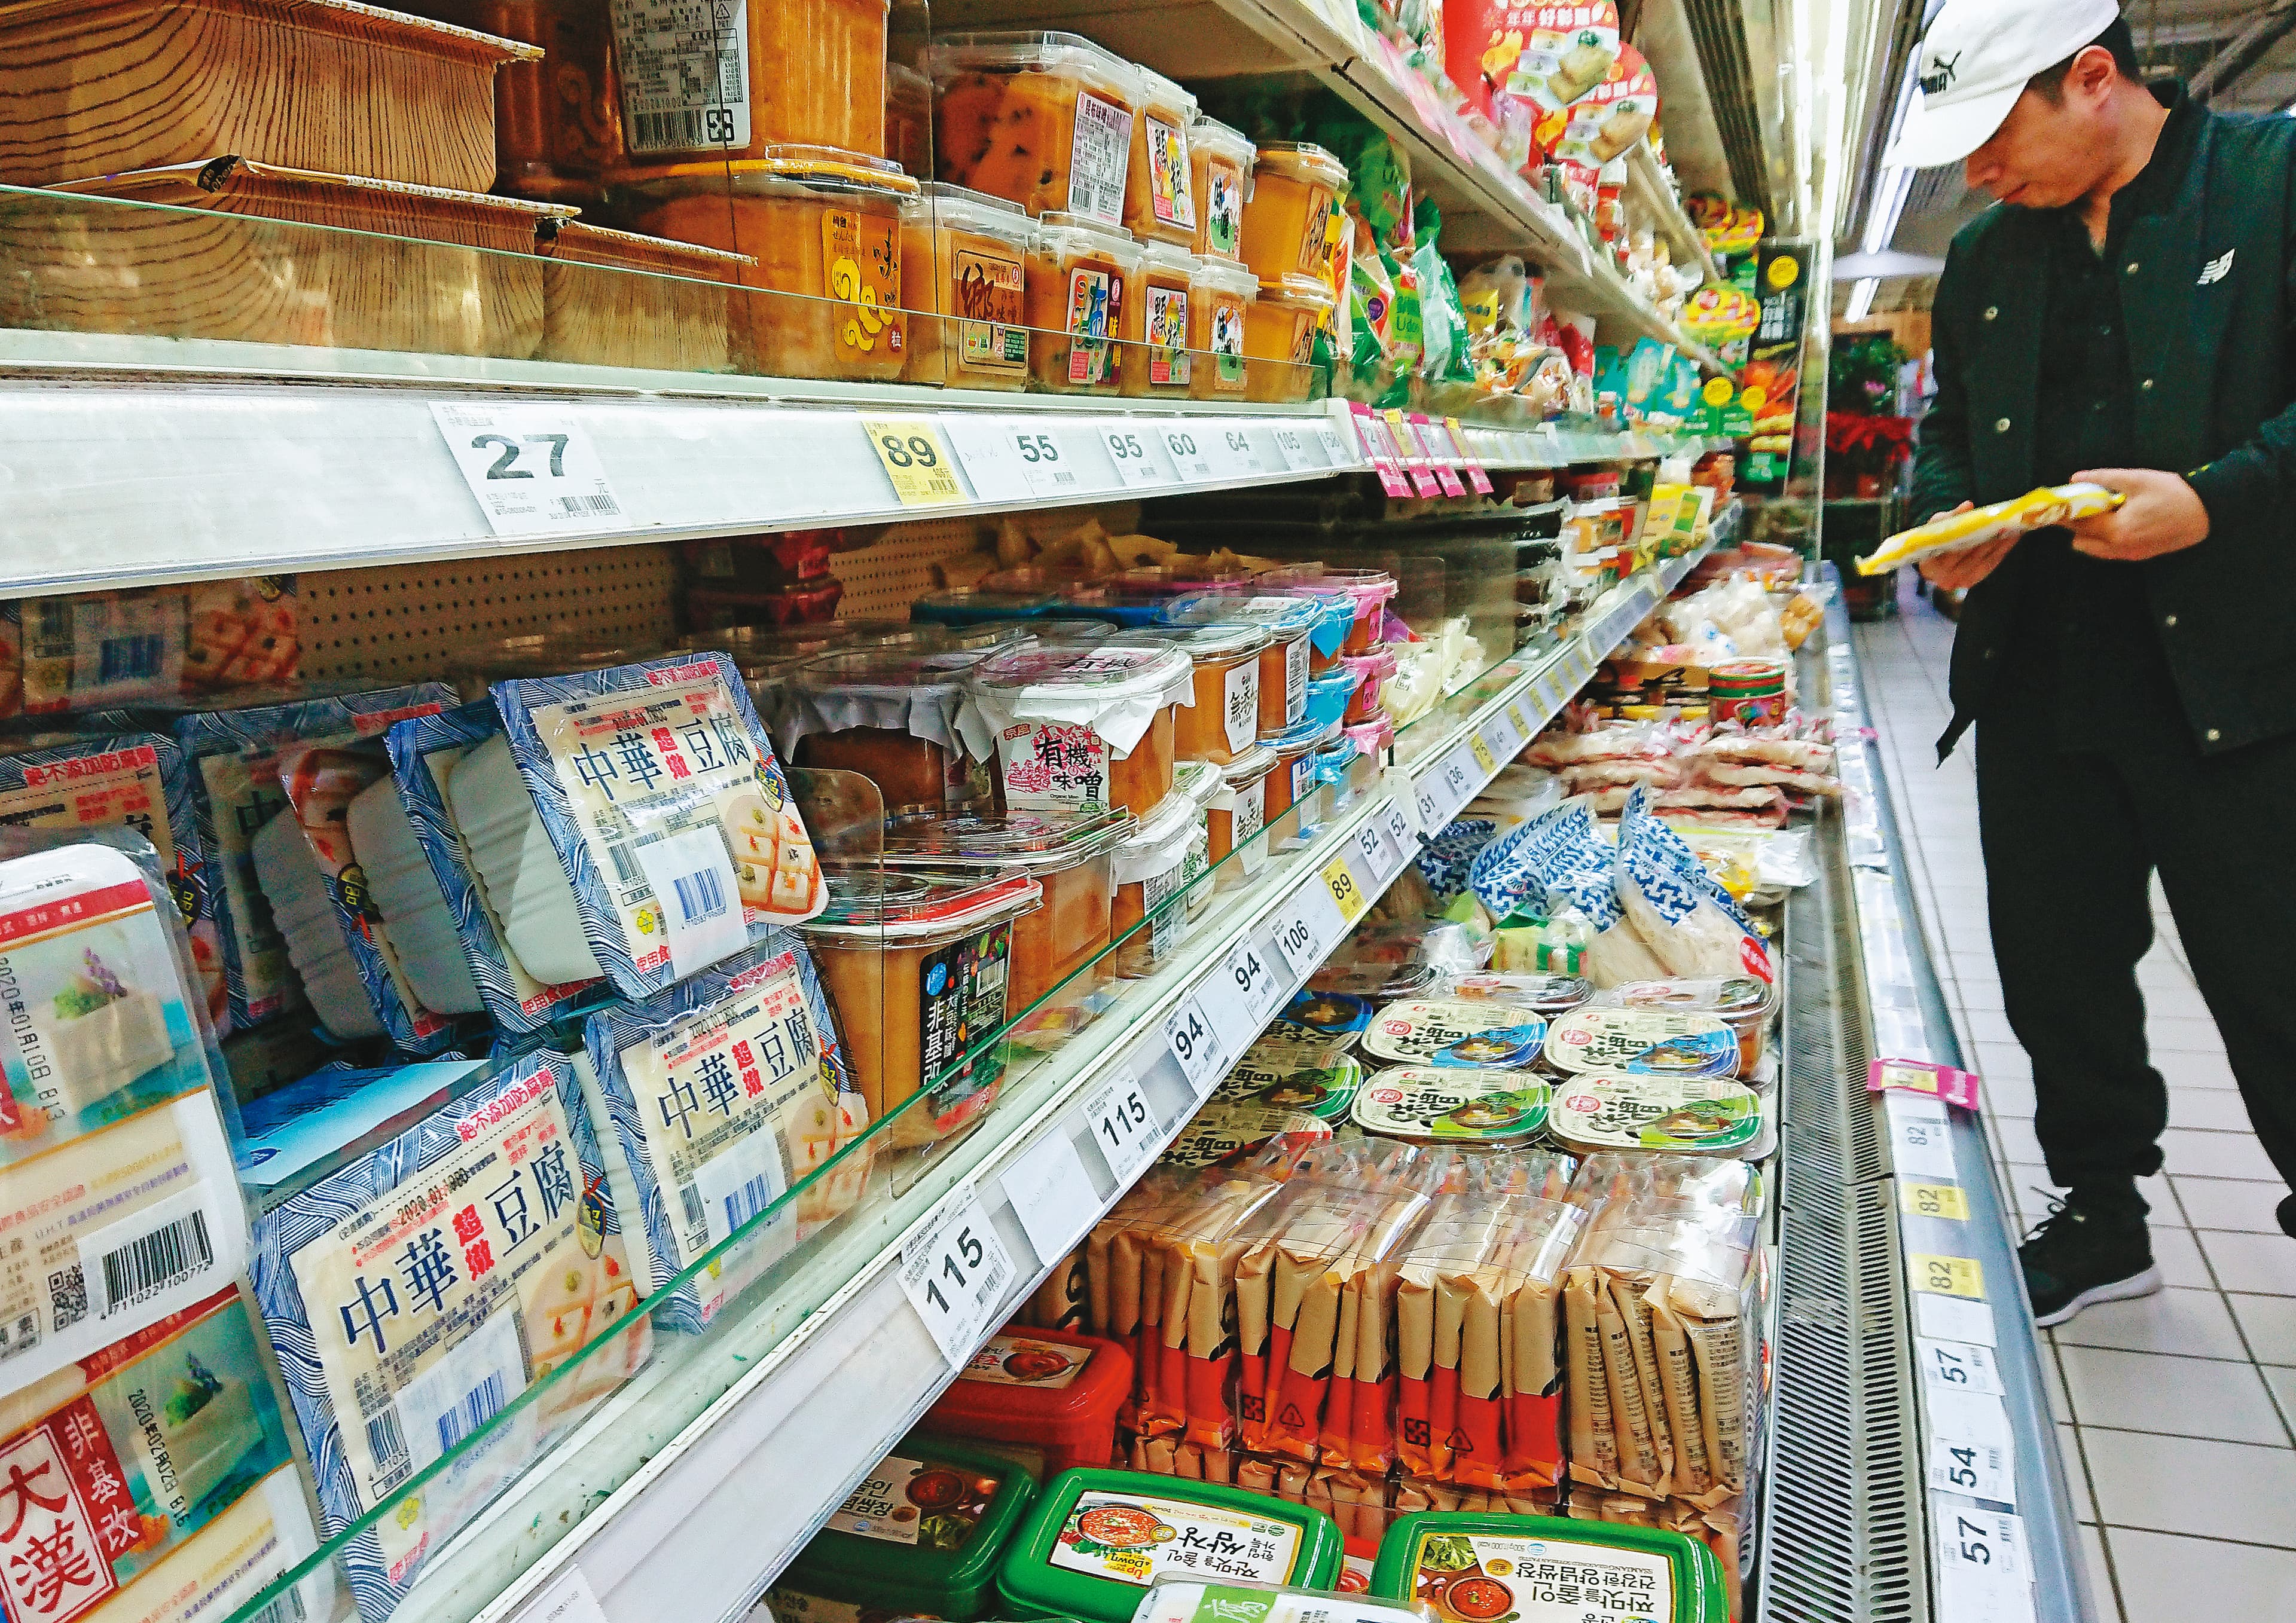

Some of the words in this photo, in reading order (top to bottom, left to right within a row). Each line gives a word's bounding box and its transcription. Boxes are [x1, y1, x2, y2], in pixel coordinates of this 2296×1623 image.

[881, 435, 937, 467] 89
[1016, 435, 1059, 463] 55
[1109, 434, 1143, 459] 95
[1168, 432, 1197, 456] 60
[1226, 431, 1250, 452] 64
[1277, 431, 1300, 450] 105
[471, 434, 569, 480] 27
[570, 732, 662, 802] 中華
[675, 714, 753, 774] 豆腐
[1035, 738, 1092, 768] 有機
[1052, 770, 1104, 799] 味噌
[1449, 766, 1464, 784] 36
[1424, 793, 1436, 814] 31
[1391, 811, 1407, 838] 52
[1360, 827, 1379, 855] 52
[1332, 873, 1353, 900] 89
[1283, 919, 1309, 956] 106
[1234, 951, 1261, 992] 94
[1175, 1012, 1204, 1061] 94
[657, 1051, 740, 1139] 中華
[753, 1005, 816, 1087] 豆腐
[1102, 1091, 1146, 1147] 115
[1907, 1126, 1928, 1146] 82
[1918, 1188, 1941, 1214] 82
[340, 1227, 460, 1355] 中華
[485, 1139, 575, 1258] 豆腐
[926, 1226, 983, 1314] 115
[1928, 1261, 1953, 1290] 82
[1935, 1347, 1968, 1384] 57
[64, 1410, 140, 1552] 非基改
[1949, 1447, 1977, 1488] 54
[0, 1459, 97, 1614] 大漢
[1177, 1526, 1246, 1556] 쌈장
[1250, 1537, 1276, 1552] 가득
[1958, 1516, 1990, 1566] 57
[1167, 1548, 1198, 1569] 줄인
[1204, 1555, 1260, 1579] 짠맛을
[1247, 1546, 1274, 1562] 한입
[1125, 1566, 1143, 1580] Up
[1514, 1561, 1600, 1586] 양념쌈장
[1602, 1570, 1657, 1591] 건강한
[1531, 1581, 1582, 1606] 줄인
[1583, 1587, 1655, 1615] 짠맛을
